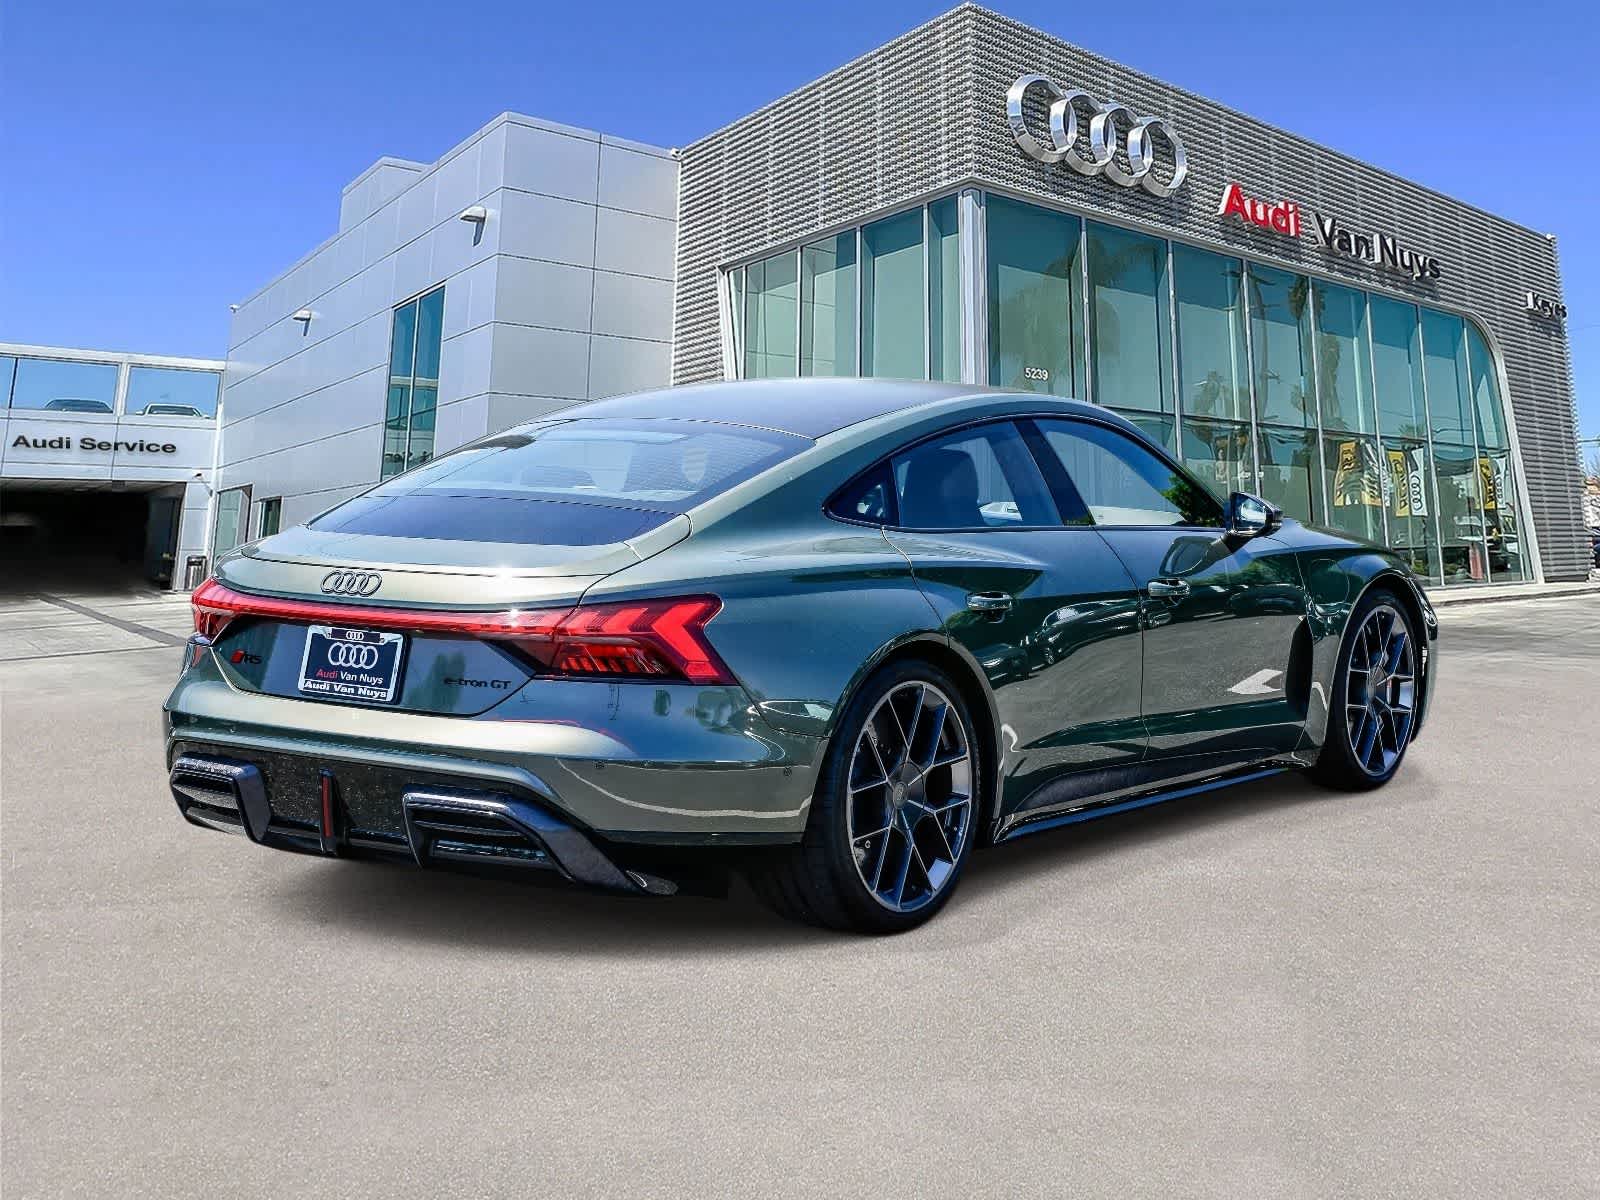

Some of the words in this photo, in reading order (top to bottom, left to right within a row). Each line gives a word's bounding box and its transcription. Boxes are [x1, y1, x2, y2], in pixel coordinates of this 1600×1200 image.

[1217, 183, 1302, 238] Audi
[1311, 212, 1374, 262] Van
[1373, 232, 1441, 281] Nuys
[1024, 367, 1049, 381] 5239
[12, 435, 71, 450] Audi
[79, 437, 177, 454] Service
[316, 668, 338, 679] Audi
[340, 670, 358, 681] Van
[359, 673, 384, 686] Nuys
[443, 677, 488, 688] e-tron
[490, 679, 512, 690] GT
[304, 680, 331, 691] Audi
[333, 684, 355, 694] Van
[357, 688, 387, 698] Nuys
